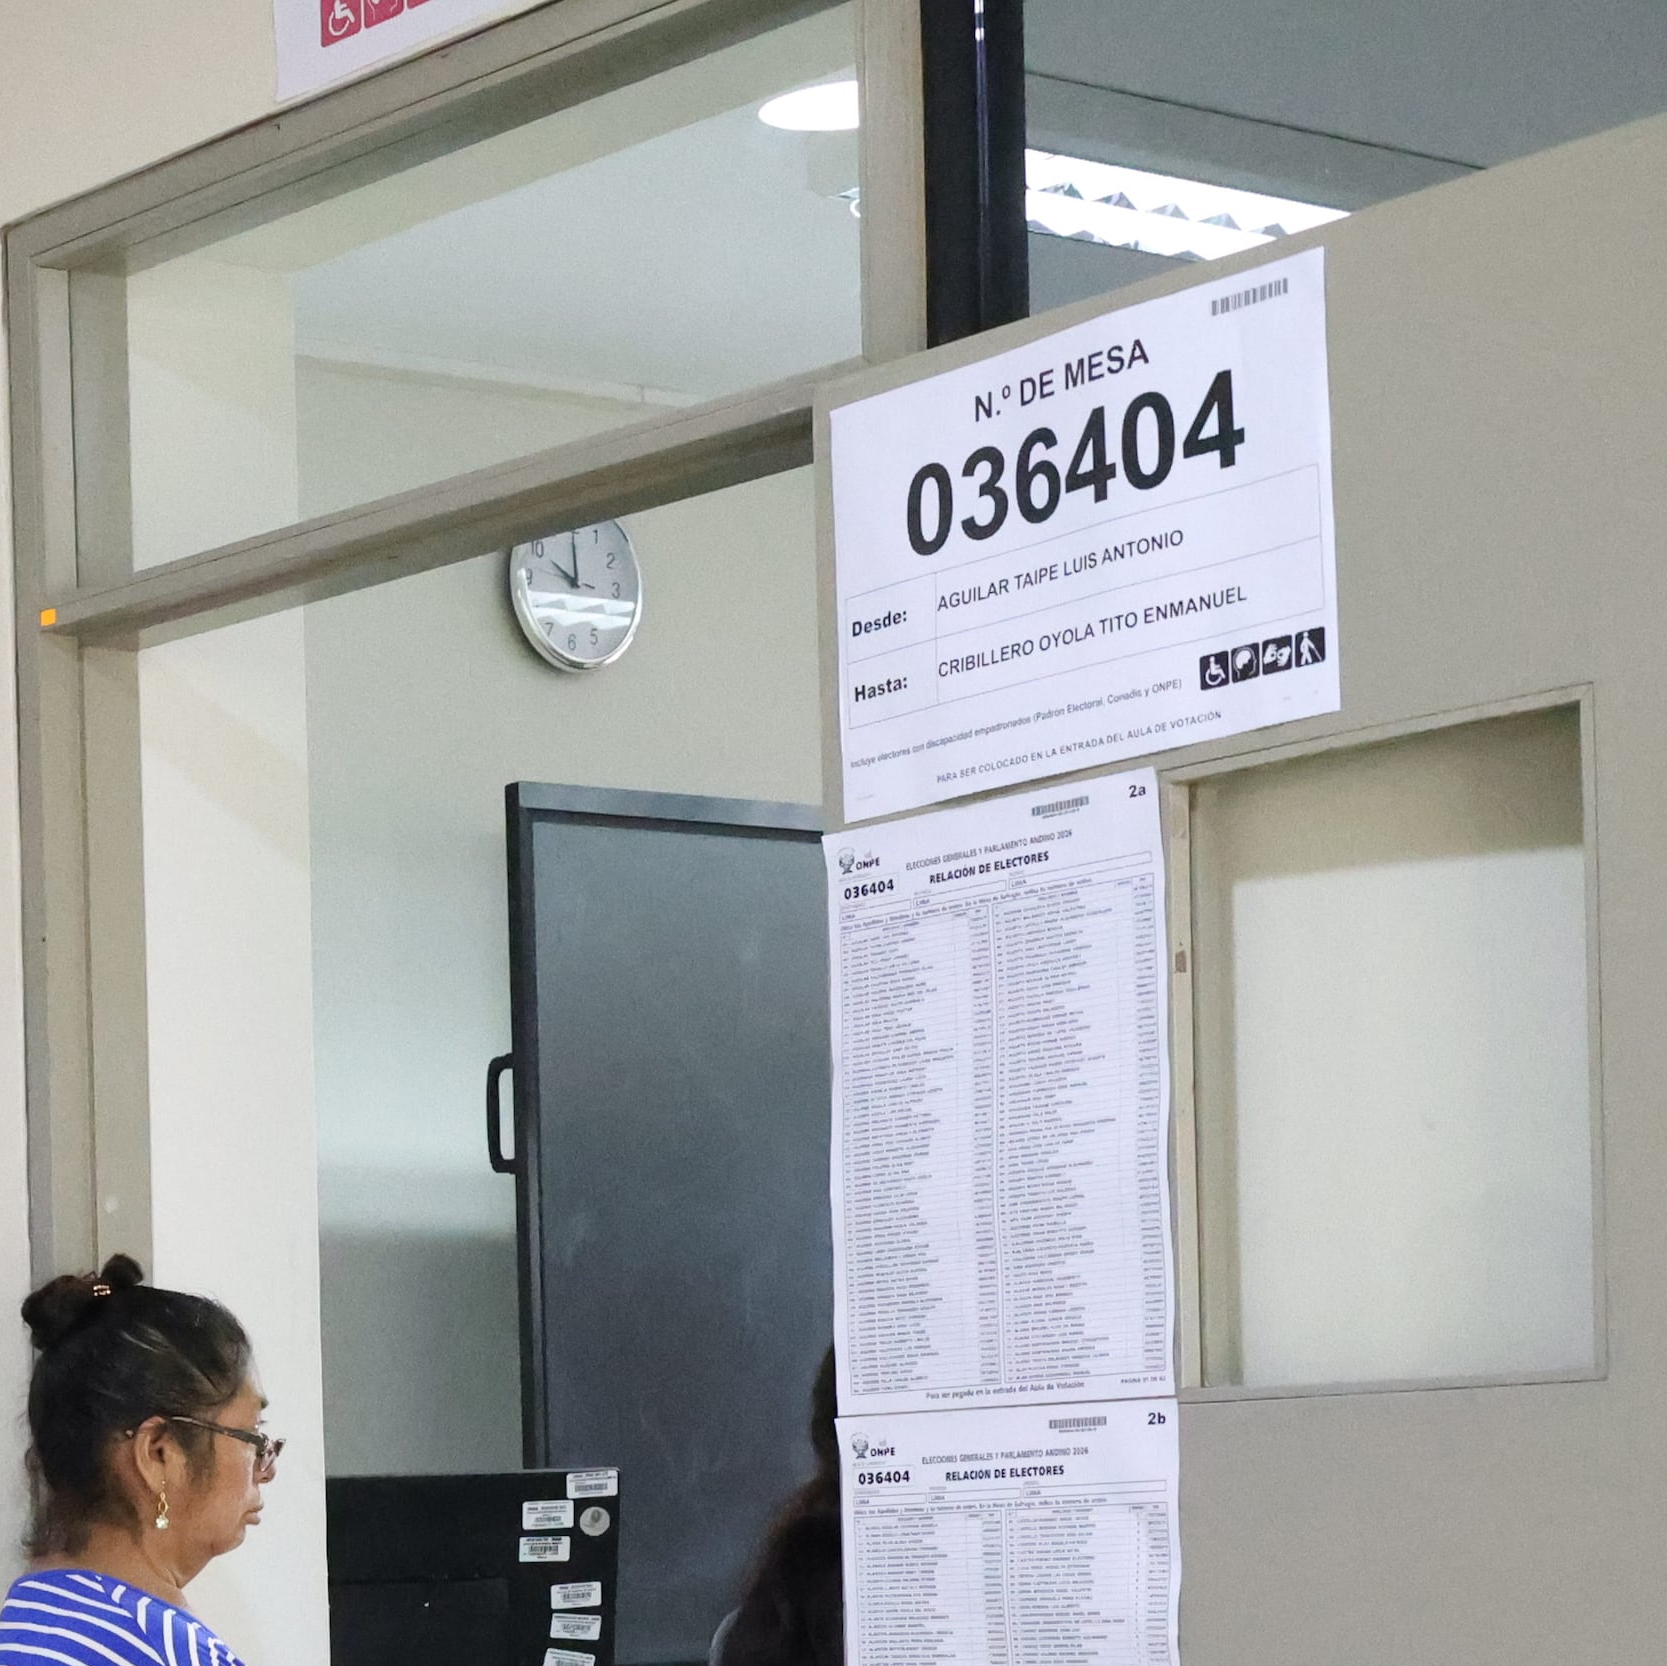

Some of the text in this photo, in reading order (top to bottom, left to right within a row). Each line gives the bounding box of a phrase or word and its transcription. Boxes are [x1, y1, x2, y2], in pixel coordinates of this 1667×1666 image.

[1020, 369, 1055, 406] DE
[1065, 339, 1149, 390] MESA
[906, 369, 1246, 556] 036404
[937, 529, 1184, 612] AGUILAR TAIPE LUIS ANTONIO
[852, 609, 908, 637] Desde:
[938, 584, 1248, 679] CRIBILLERO OYOLA TITO ENMANUEL
[854, 674, 908, 703] Hasta:
[878, 746, 911, 762] electores
[926, 730, 973, 750] discapacidad
[974, 716, 1032, 736] empadronados
[1107, 689, 1142, 705] Conadis
[1144, 688, 1150, 697] y
[1152, 678, 1182, 694] ONPE)
[936, 711, 1222, 784] PARA SER COLOCADO EN LA ENTRADA DEL AULA DE VOTACIÓN
[1129, 785, 1146, 798] 2a
[856, 857, 880, 871] ONPE
[906, 857, 942, 871] ELECCIONES
[984, 838, 1028, 854] PARLAMENTO
[1030, 832, 1056, 845] ANDINO
[978, 862, 992, 874] DE
[994, 851, 1050, 871] ELECTORES
[844, 878, 895, 900] 036404
[1148, 1412, 1166, 1425] 2b
[870, 1447, 896, 1457] ONPE
[960, 1454, 994, 1462] GENERALES
[1000, 1448, 1044, 1460] PARLAMENTO
[1045, 1447, 1071, 1458] ANDINO
[1073, 1446, 1089, 1455] 2026
[858, 1470, 910, 1485] 036404
[994, 1468, 1007, 1478] DE
[1010, 1464, 1065, 1478] ELECTORES
